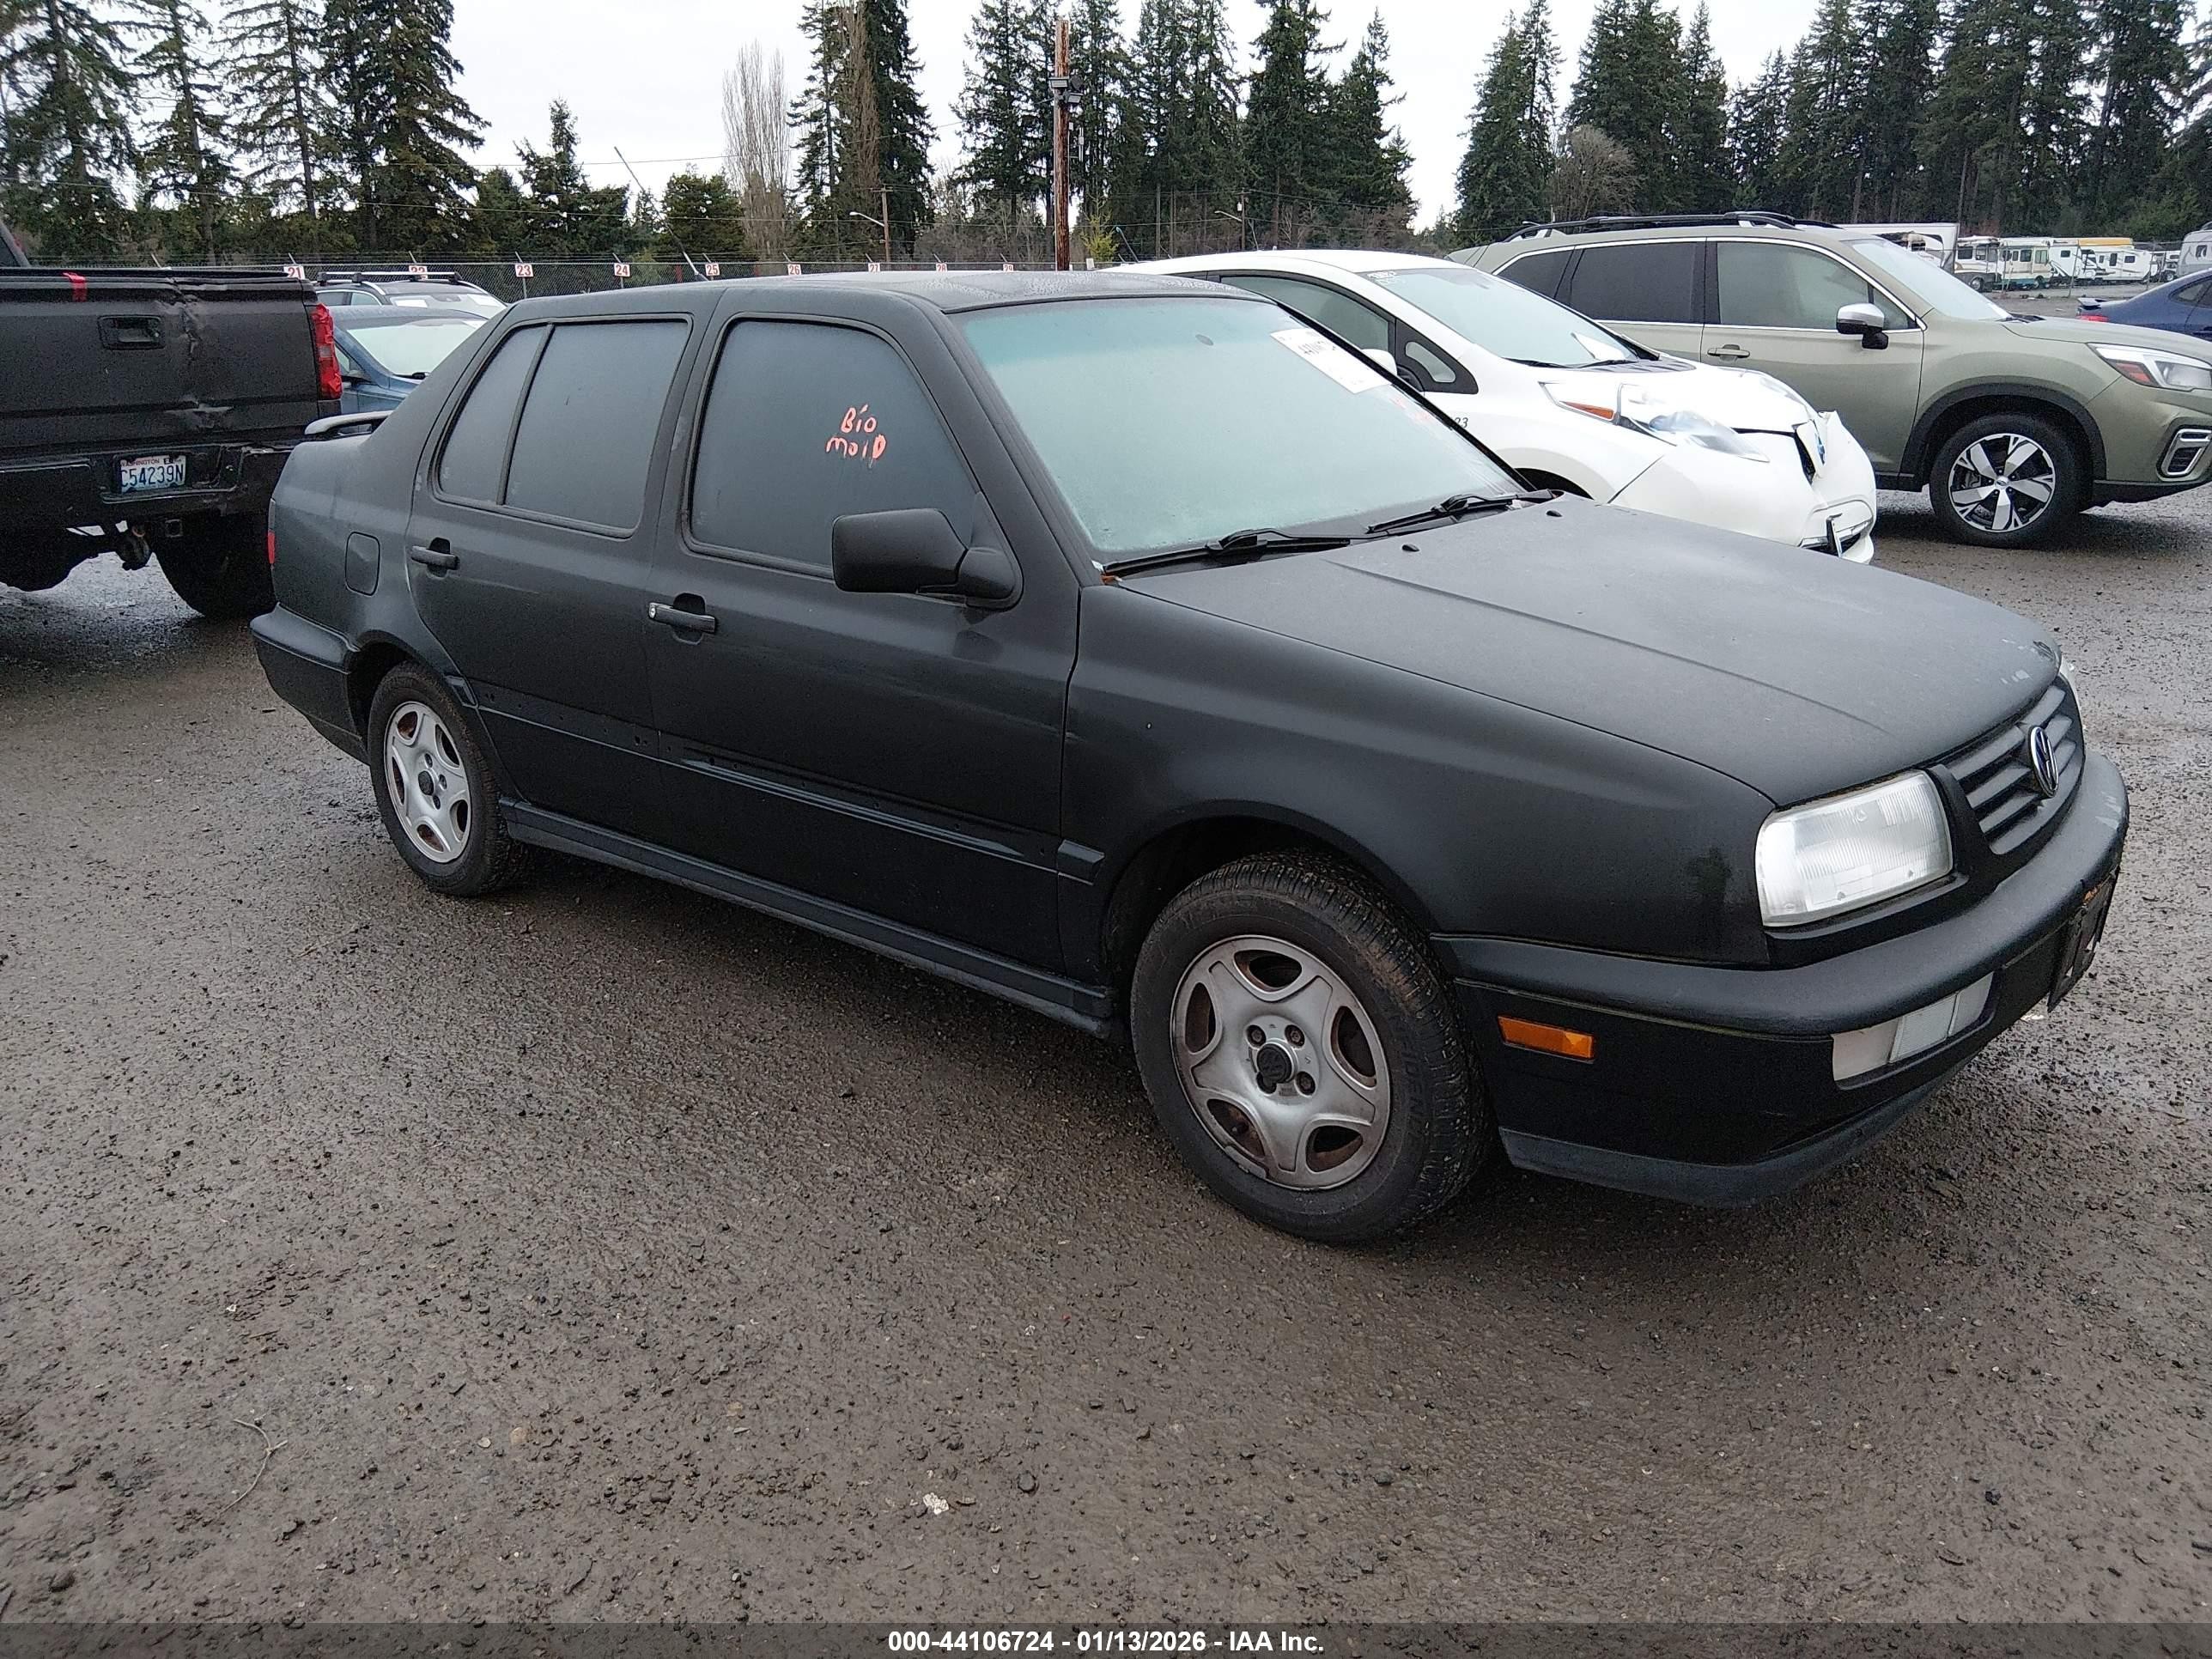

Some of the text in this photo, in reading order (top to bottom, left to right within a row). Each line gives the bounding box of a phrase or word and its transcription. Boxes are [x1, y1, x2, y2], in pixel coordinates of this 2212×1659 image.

[289, 267, 301, 278] 21
[517, 265, 532, 276] 23
[616, 265, 628, 276] 24
[707, 264, 719, 275] 25
[789, 265, 800, 275] 26
[121, 464, 184, 488] C54239N
